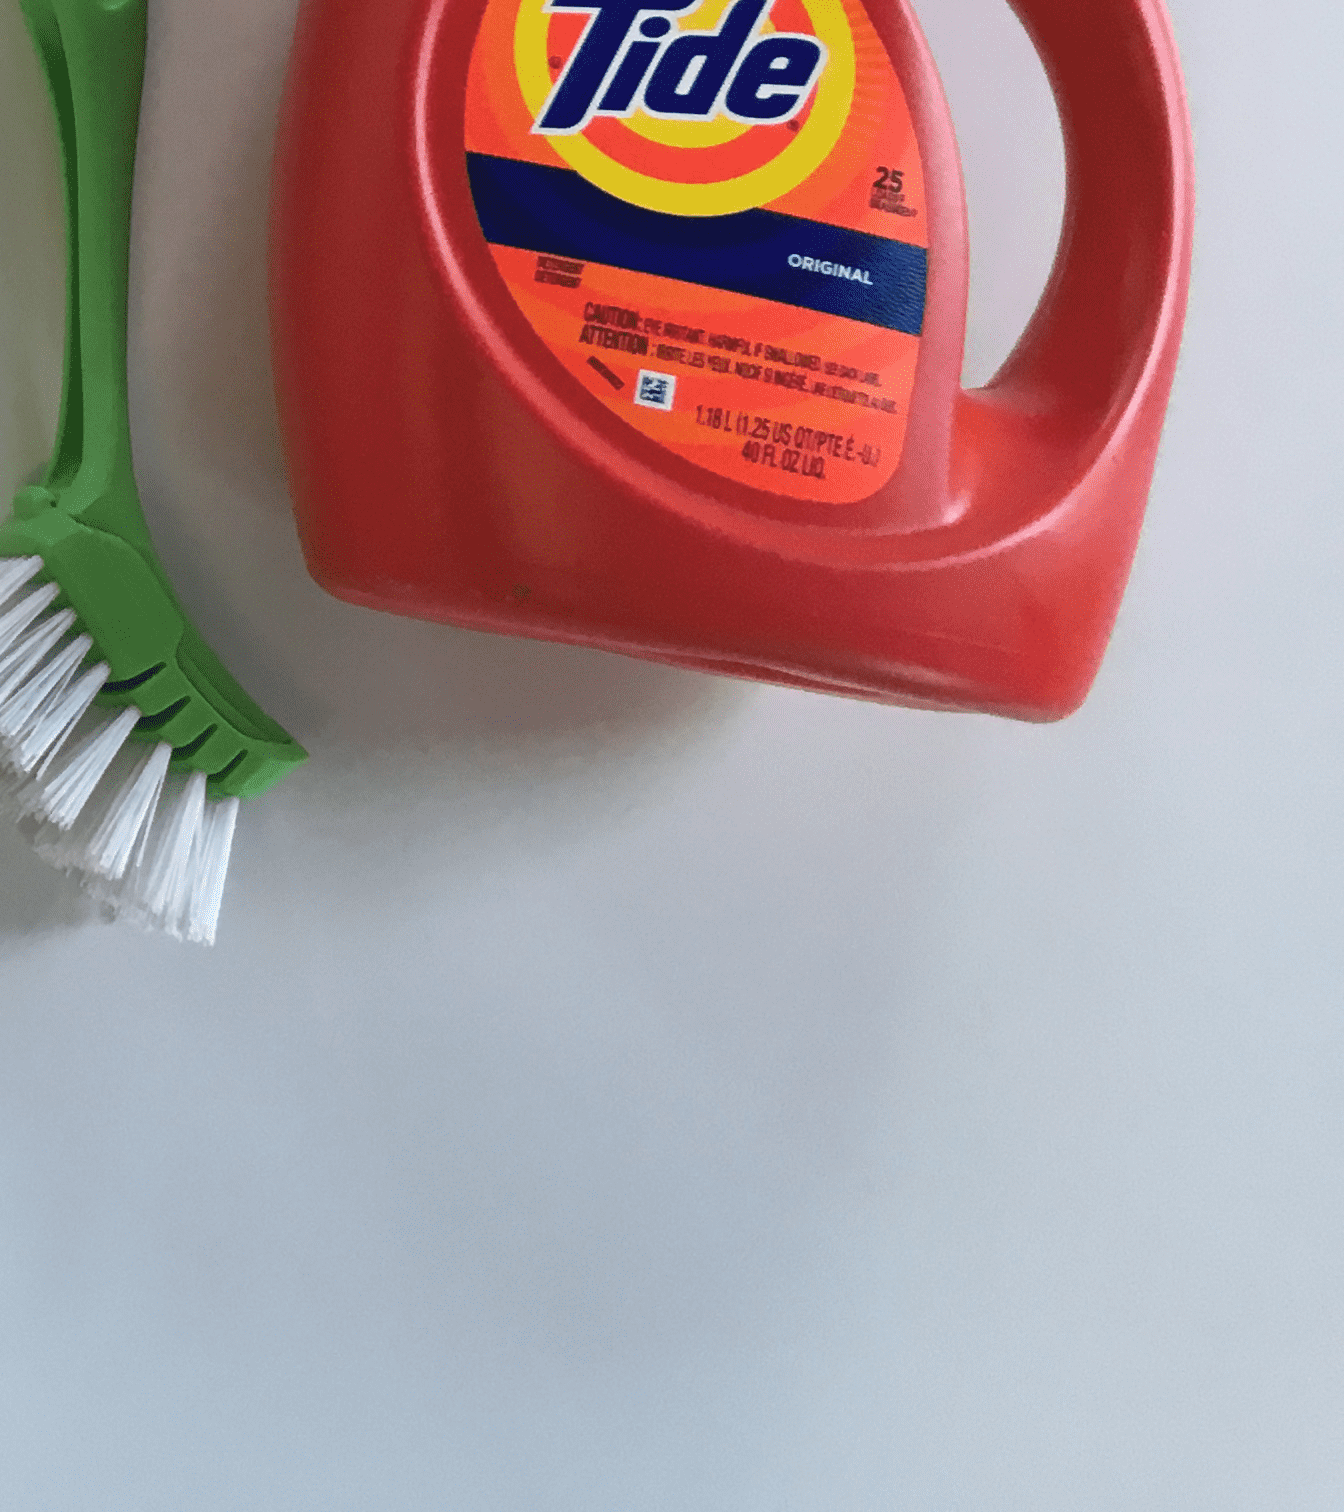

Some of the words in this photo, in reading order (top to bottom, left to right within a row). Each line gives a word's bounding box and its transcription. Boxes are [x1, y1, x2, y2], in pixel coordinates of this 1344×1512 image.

[873, 166, 905, 193] 25
[786, 252, 874, 287] ORIGINAL
[695, 404, 723, 430] 1.18
[772, 421, 793, 446] US
[762, 442, 778, 468] FL
[780, 448, 801, 474] OZ
